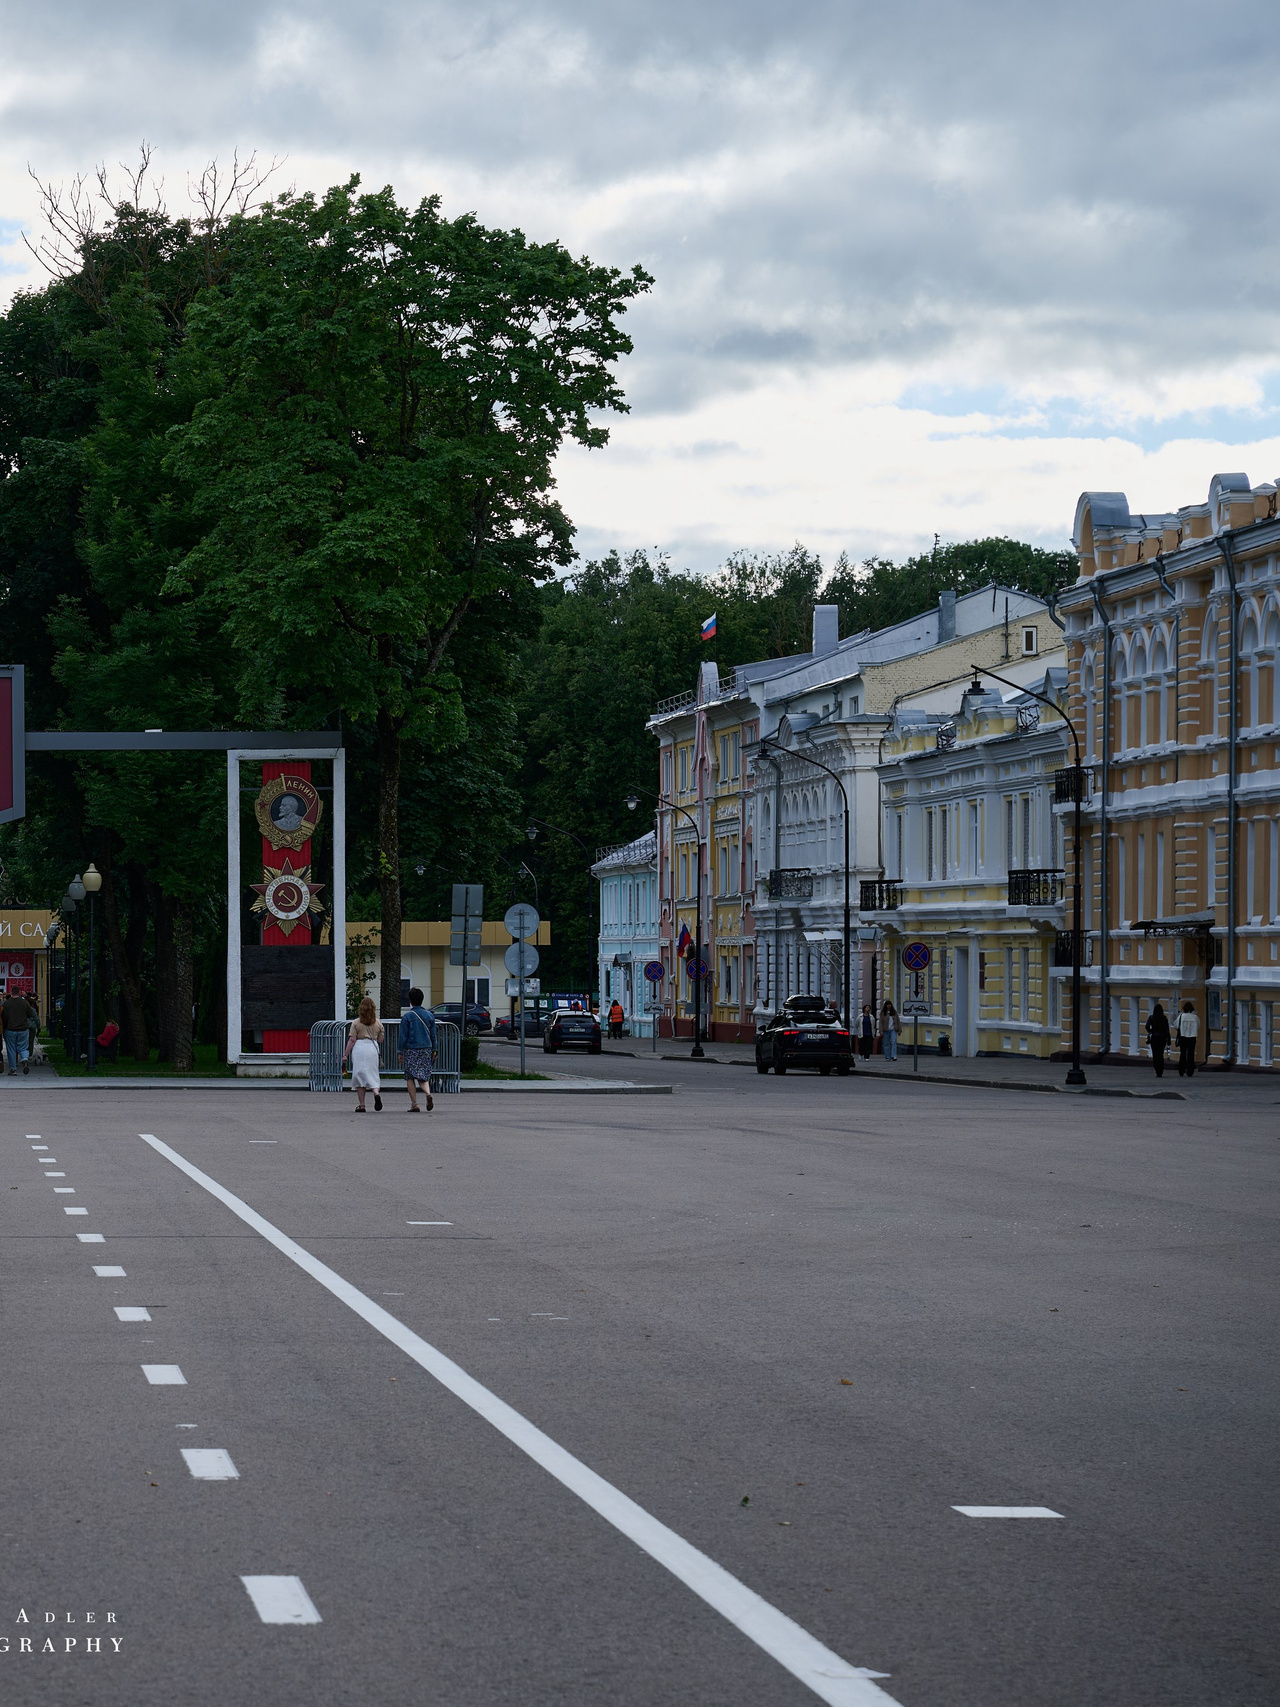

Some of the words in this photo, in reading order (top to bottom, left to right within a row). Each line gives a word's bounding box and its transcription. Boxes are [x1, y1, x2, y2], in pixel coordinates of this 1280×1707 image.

[286, 781, 315, 798] ЛЕНИН
[266, 876, 304, 915] ОТЕЧЕСТВЕННАЯ
[296, 890, 308, 915] ВОЙНА
